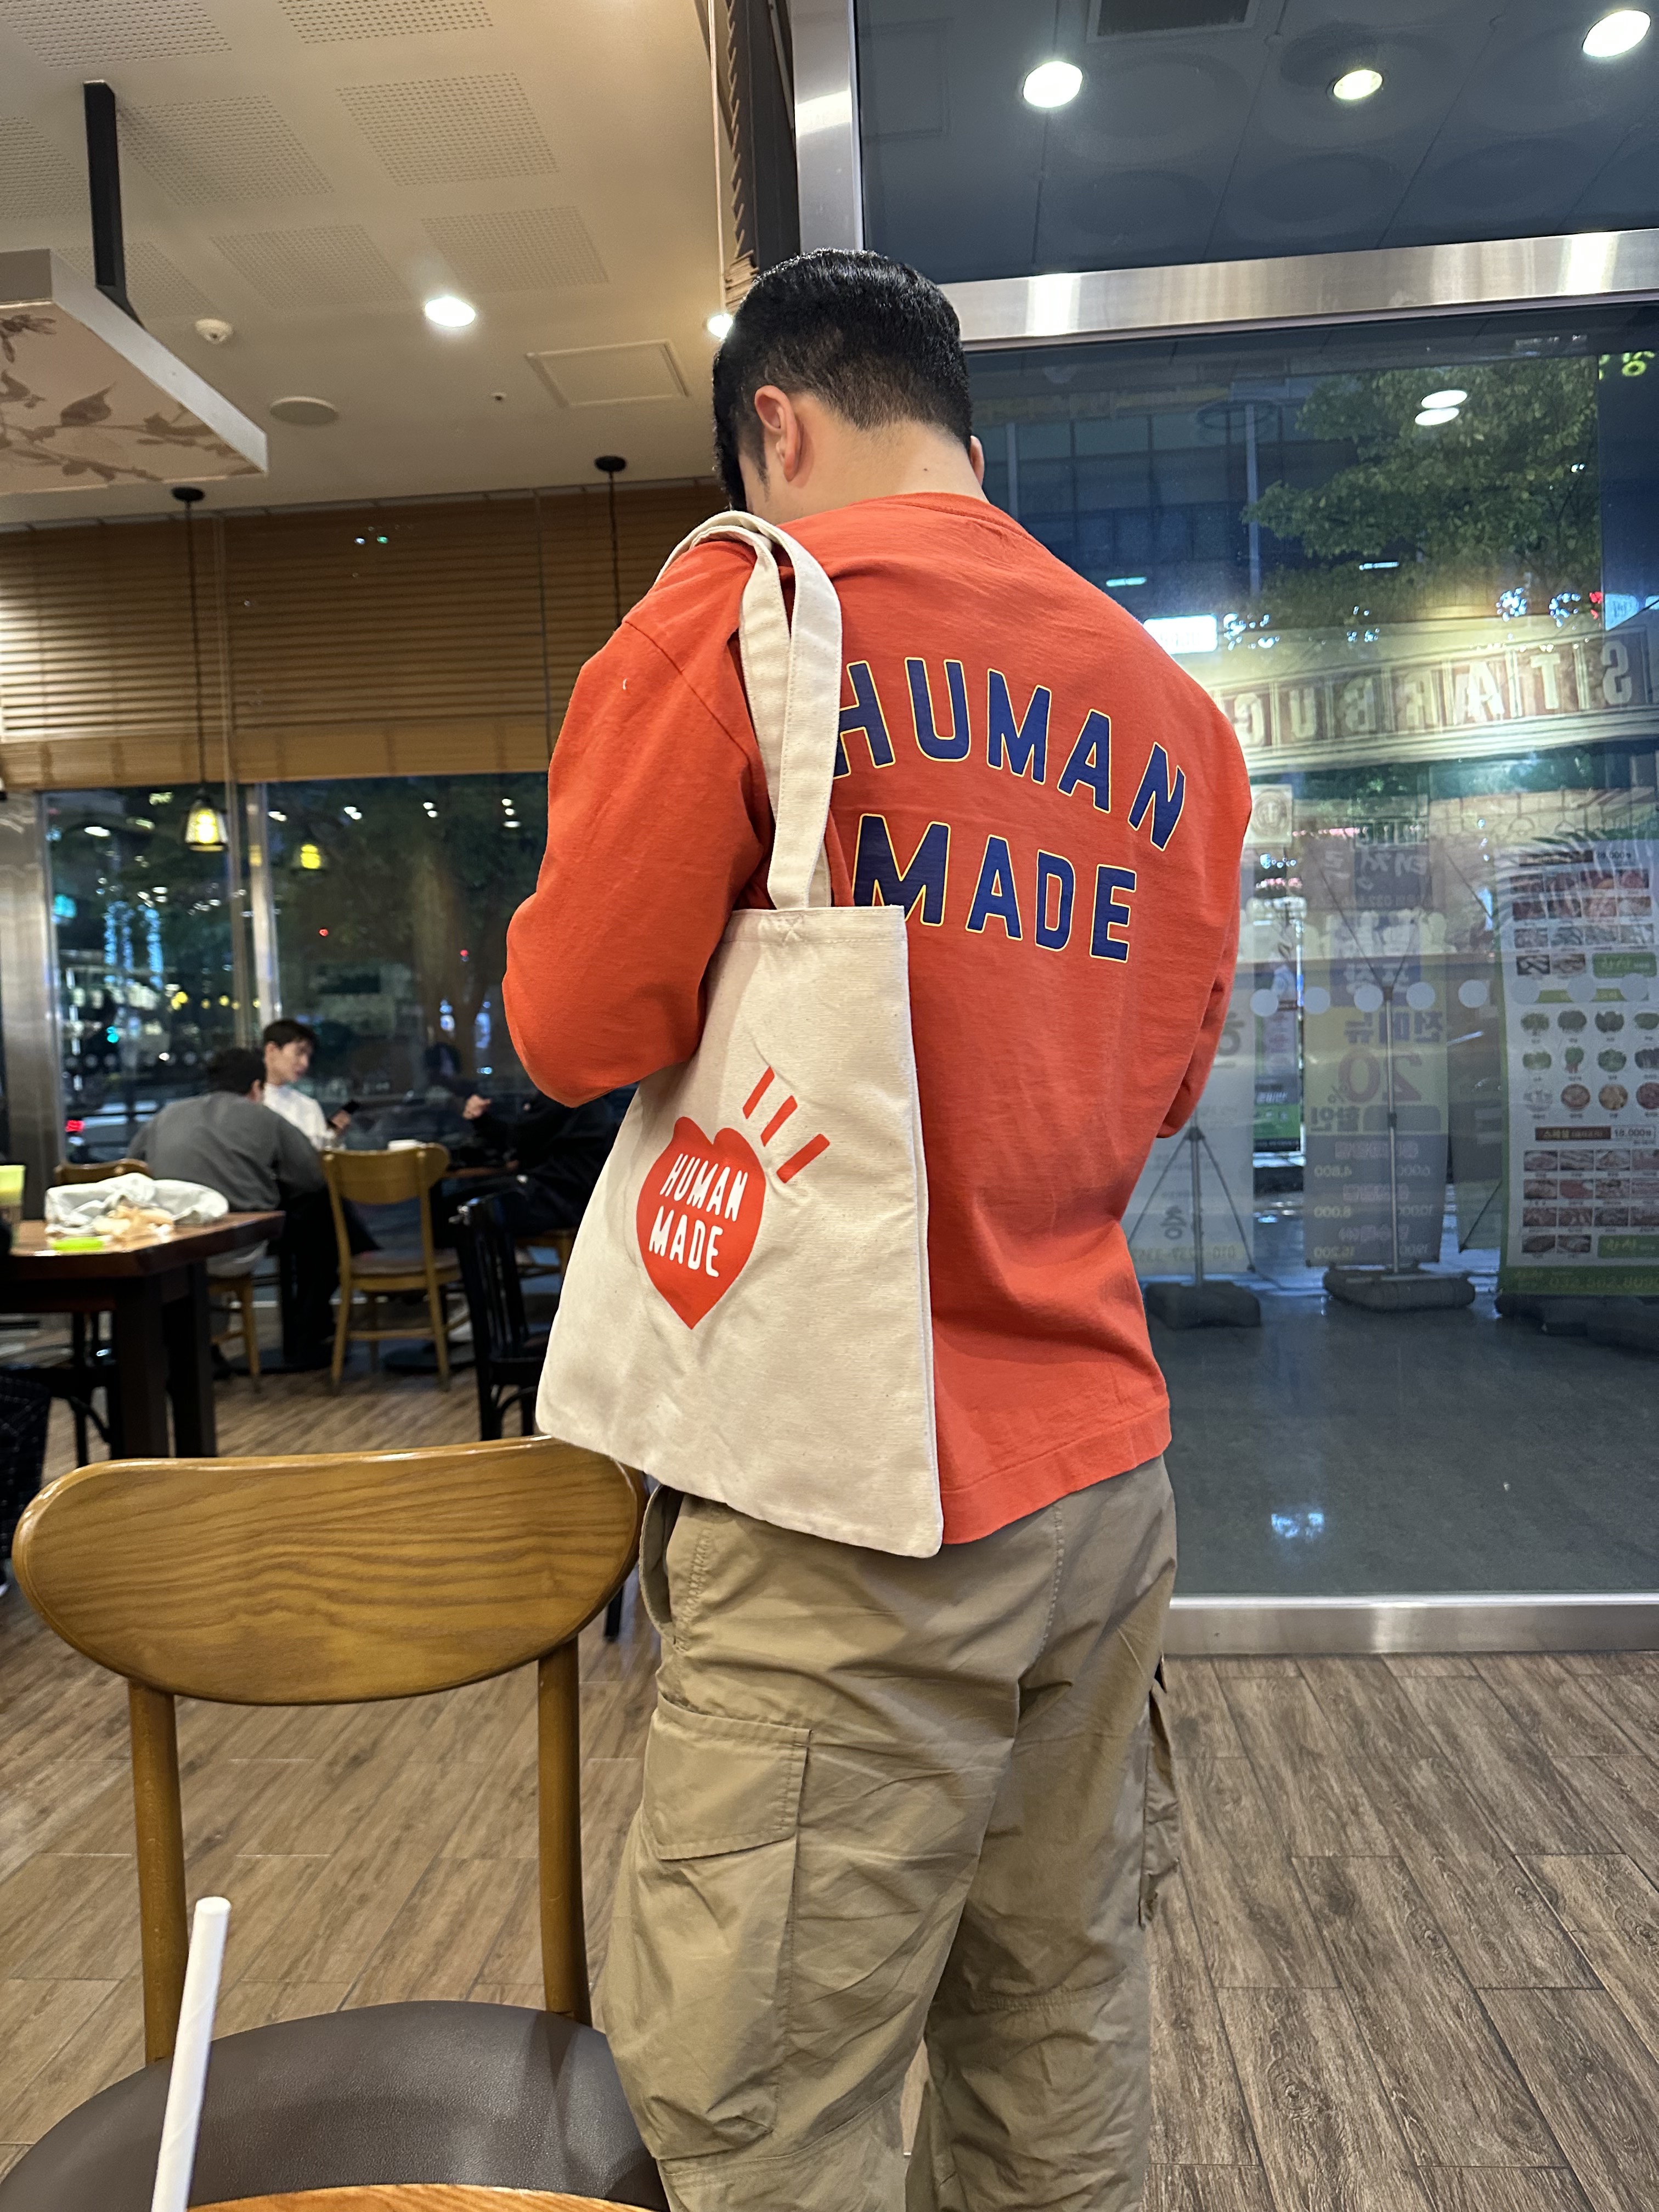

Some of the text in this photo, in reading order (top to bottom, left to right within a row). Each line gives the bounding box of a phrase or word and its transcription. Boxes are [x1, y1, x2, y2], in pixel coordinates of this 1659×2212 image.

[833, 657, 1186, 851] HUMAN
[853, 814, 1137, 963] MADE
[649, 1205, 724, 1278] MADE
[659, 1153, 748, 1222] HUMAN
